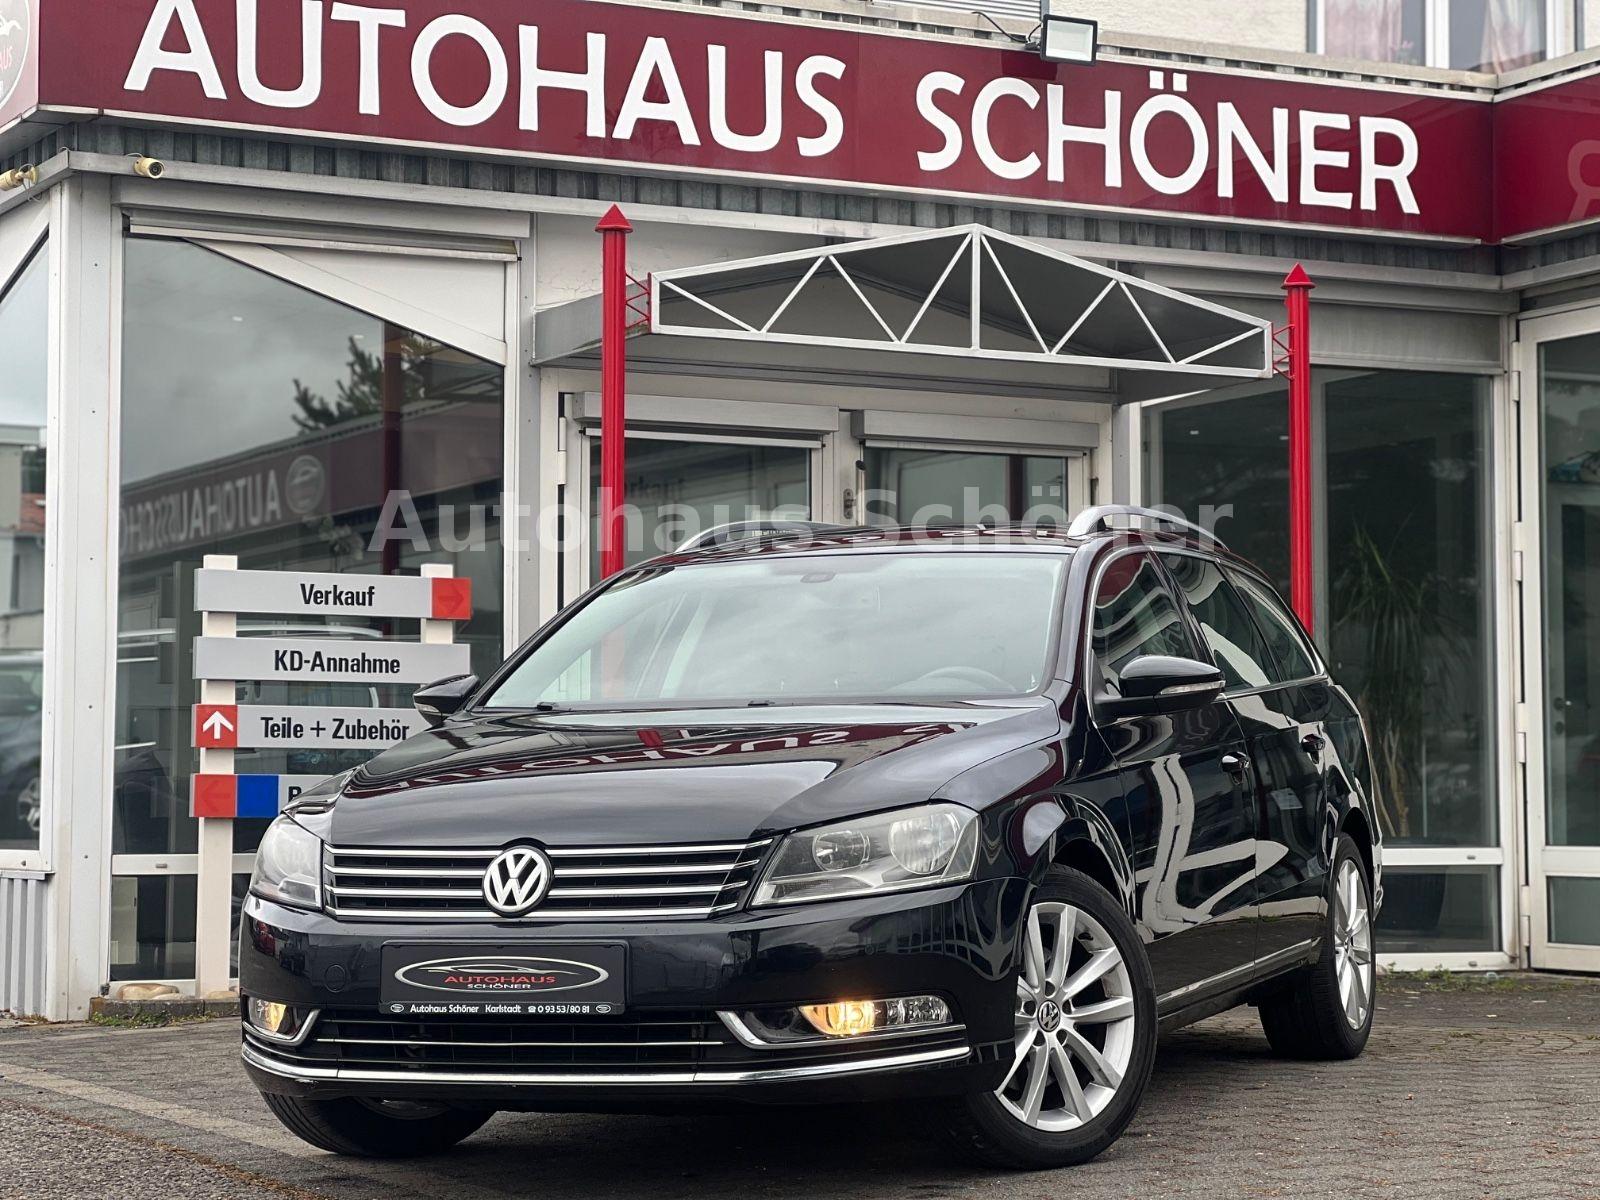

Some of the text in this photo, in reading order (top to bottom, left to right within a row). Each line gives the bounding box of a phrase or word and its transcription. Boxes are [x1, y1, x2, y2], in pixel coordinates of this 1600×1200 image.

[124, 0, 846, 158] AUTOHAUS
[916, 71, 1420, 215] SCHÖNER
[300, 583, 375, 606] Verkauf
[274, 650, 400, 674] KD-Annahme
[261, 717, 409, 741] Teile + Zubehör
[484, 848, 547, 912] VW
[410, 1004, 447, 1013] Autohaus
[449, 1004, 479, 1013] Schöner
[485, 1004, 521, 1013] Karlstadt
